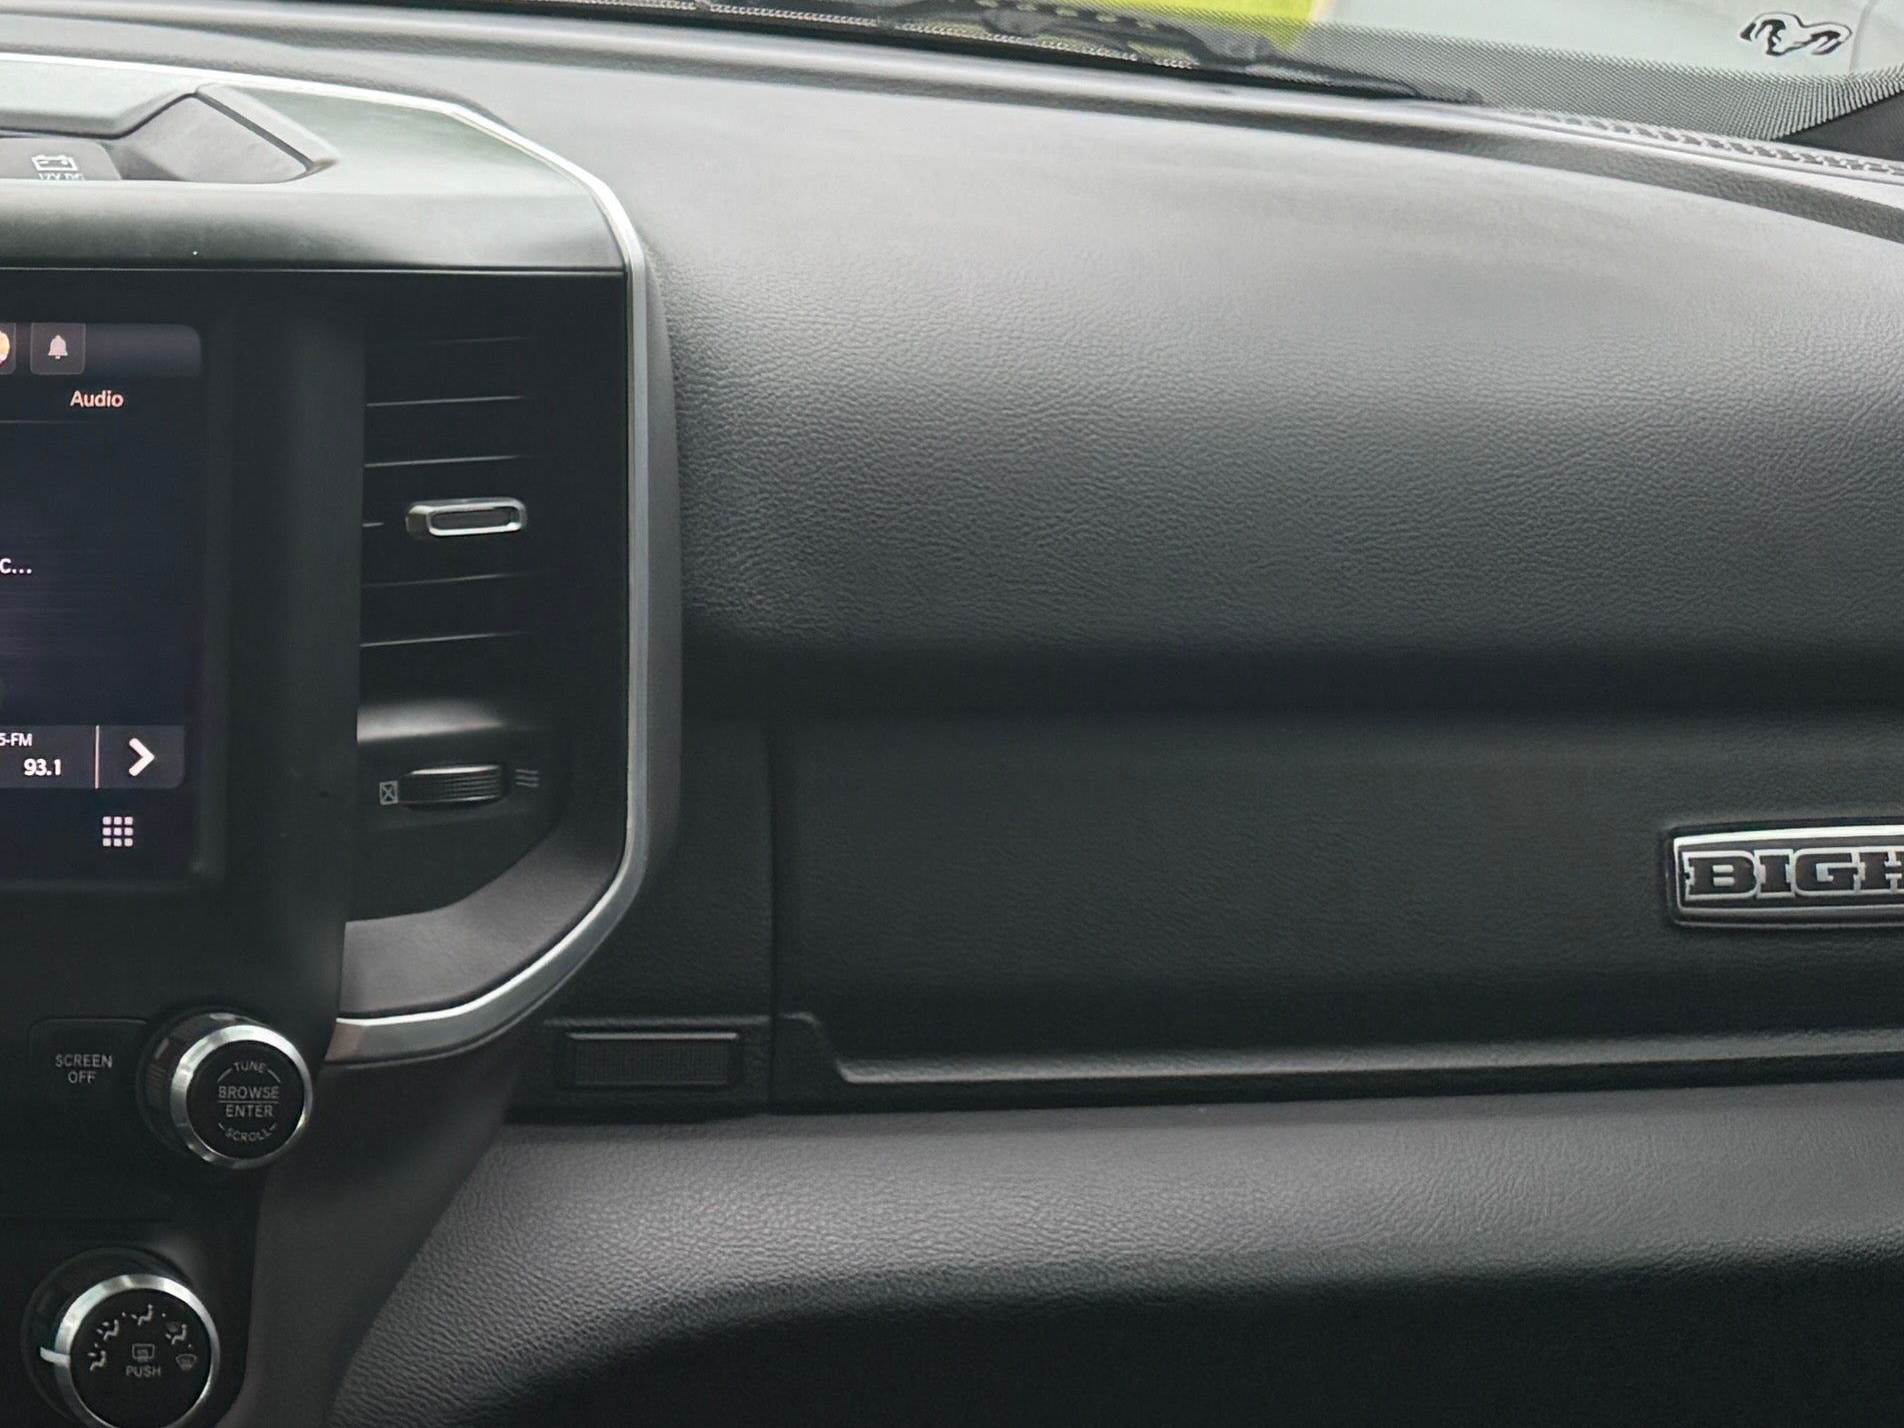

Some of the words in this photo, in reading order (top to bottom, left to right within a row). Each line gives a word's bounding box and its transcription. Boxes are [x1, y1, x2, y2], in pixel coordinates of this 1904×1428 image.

[70, 390, 123, 408] Audio
[24, 758, 61, 775] 93.1
[55, 1054, 112, 1069] SCREEN
[233, 1060, 267, 1075] TUNE
[67, 1071, 96, 1084] OFF
[217, 1085, 279, 1100] BROWSE
[225, 1104, 273, 1118] ENTER
[225, 1127, 272, 1143] SCROLL
[126, 1365, 161, 1378] PUSH
